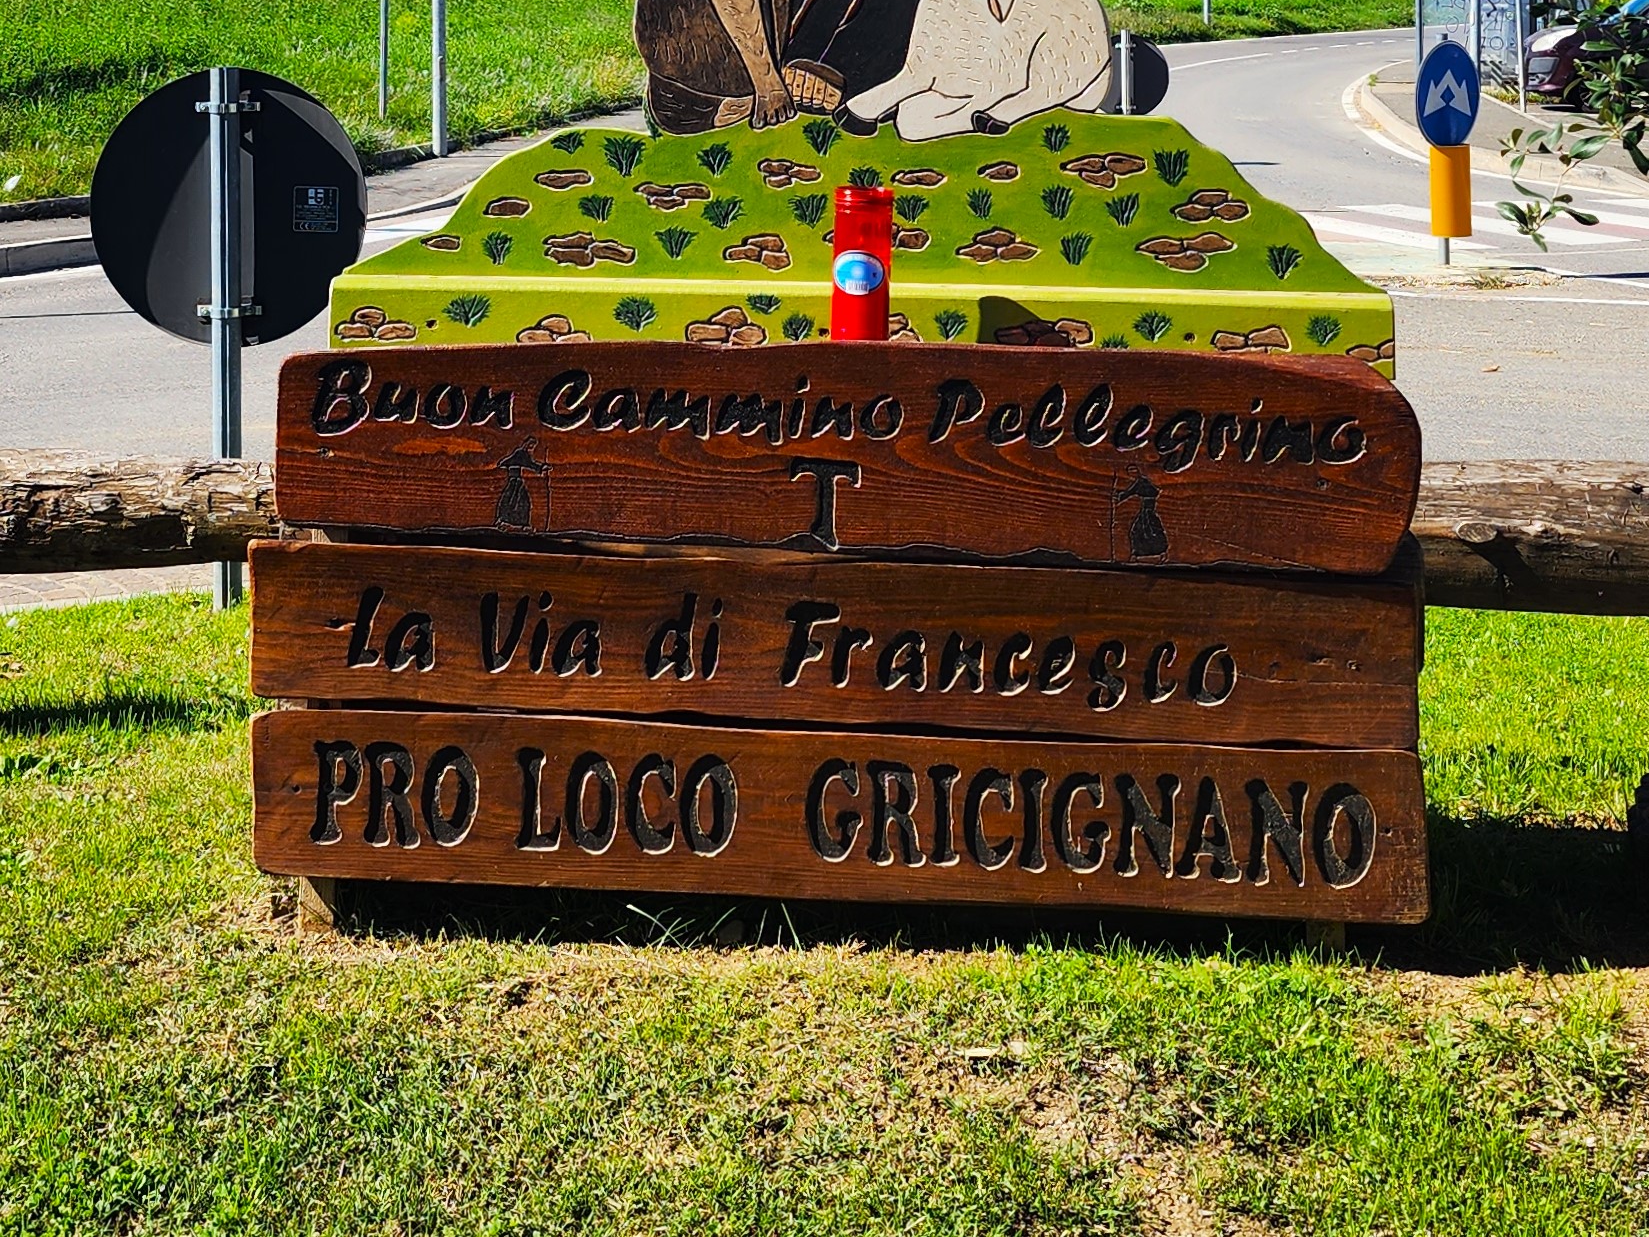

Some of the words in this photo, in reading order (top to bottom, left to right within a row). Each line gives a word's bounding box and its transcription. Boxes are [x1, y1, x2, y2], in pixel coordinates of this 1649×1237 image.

[311, 358, 516, 437] Buon
[537, 368, 904, 445] Cammino
[929, 379, 1368, 474] Pellegrino
[346, 586, 436, 673] La
[480, 590, 602, 678] Via
[645, 592, 723, 682] di
[780, 600, 1238, 712] Francesco
[309, 739, 480, 850] PRO
[514, 746, 739, 858] LOCO
[804, 757, 1378, 890] GRICIGNANO
